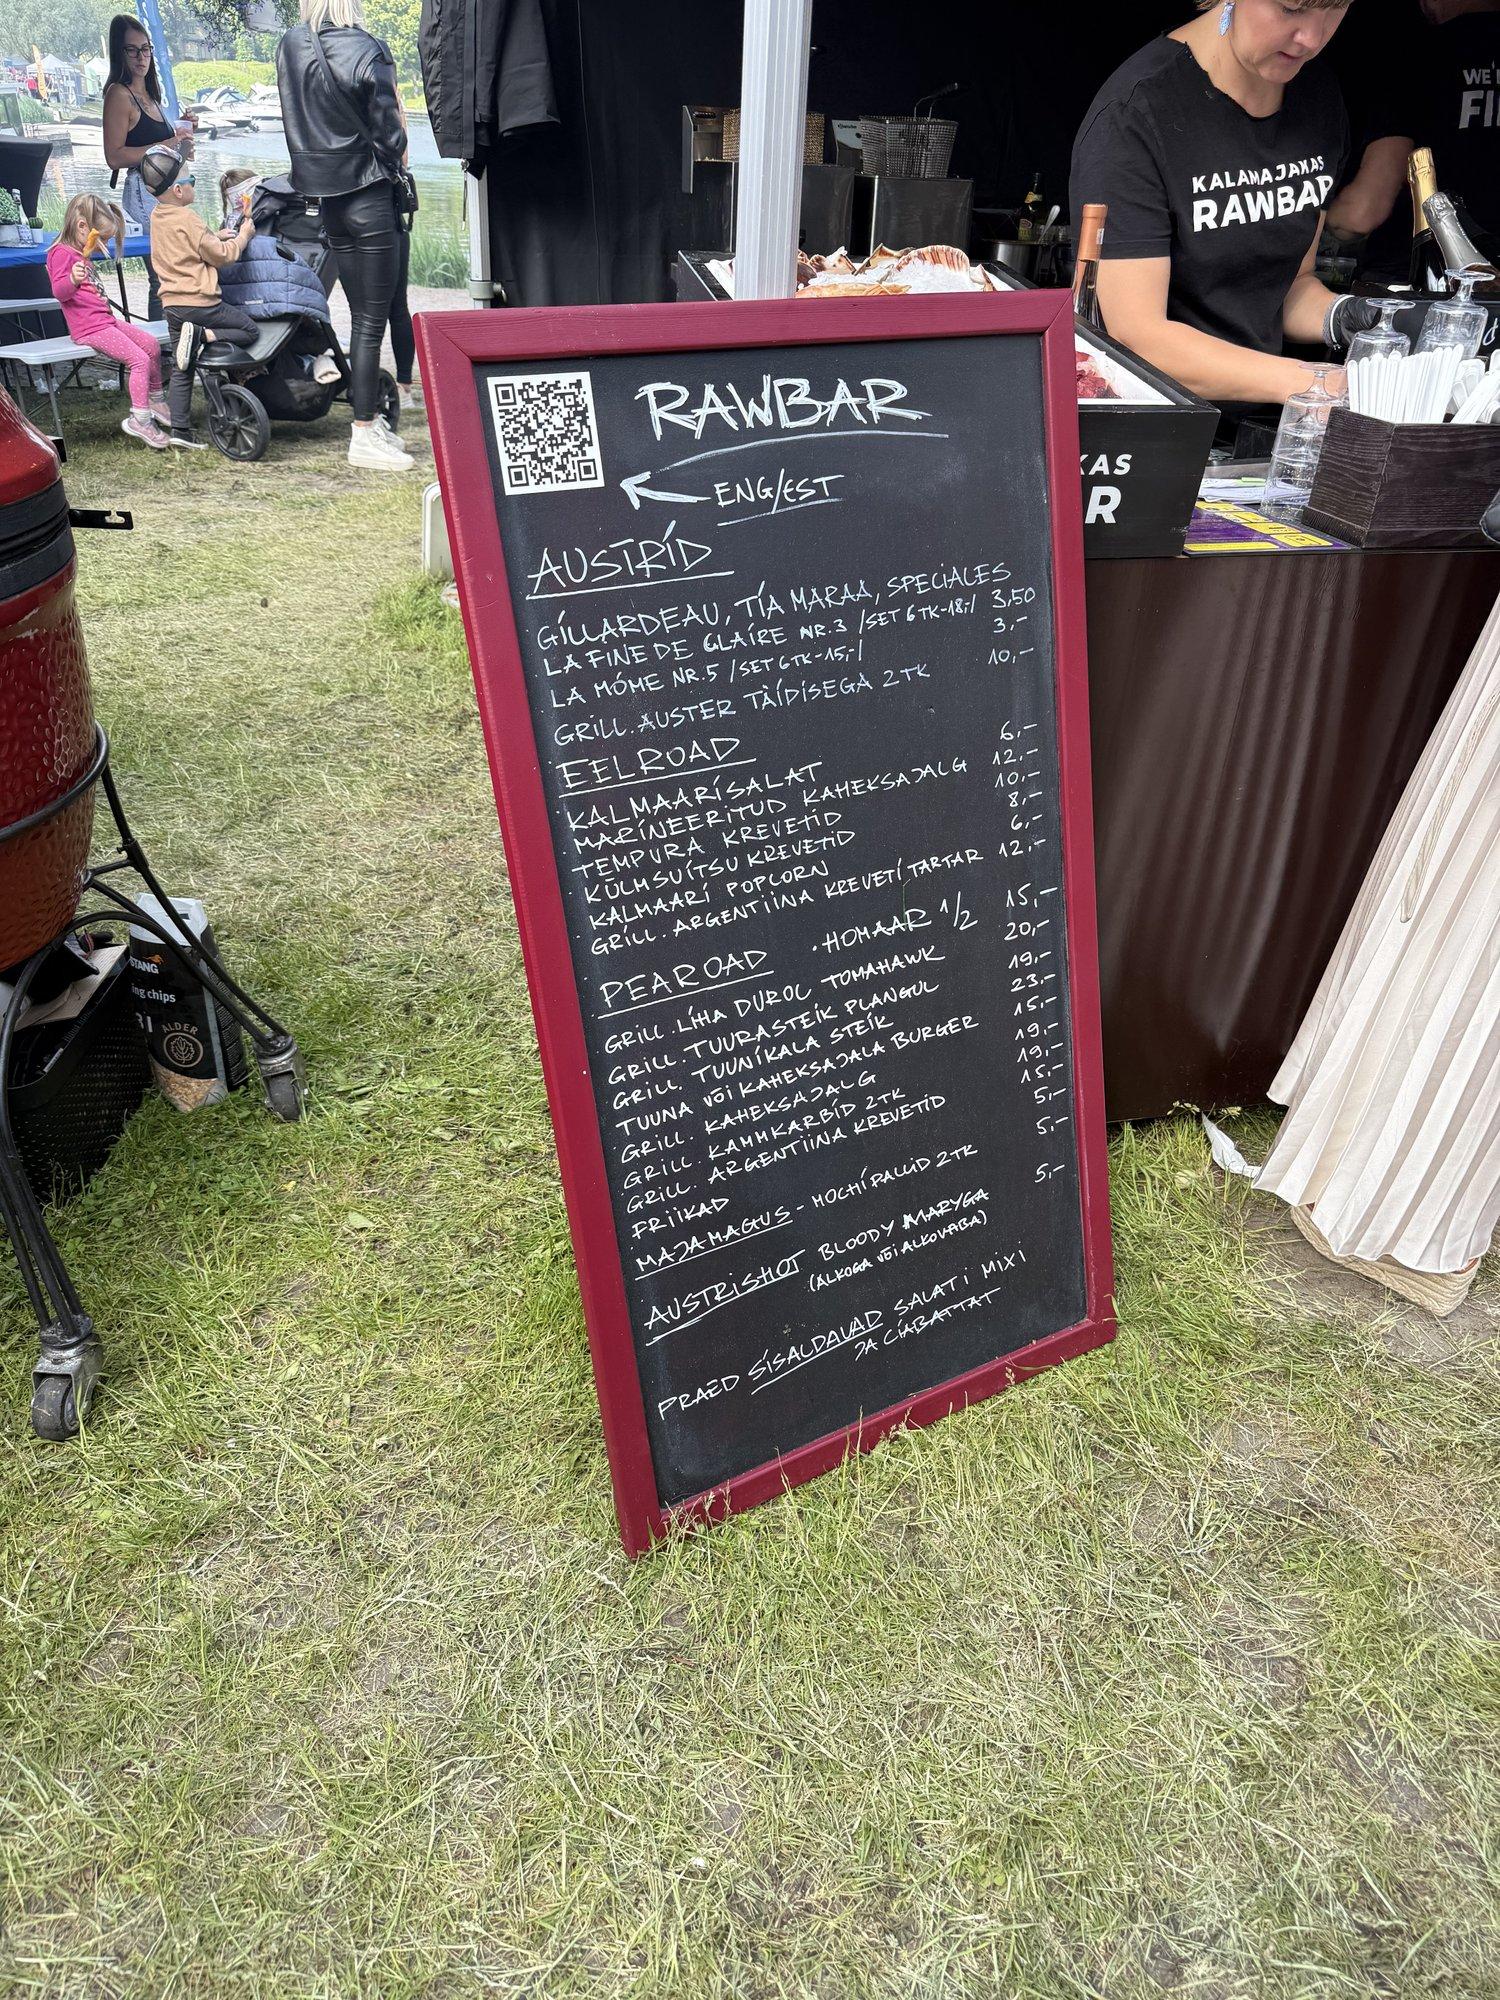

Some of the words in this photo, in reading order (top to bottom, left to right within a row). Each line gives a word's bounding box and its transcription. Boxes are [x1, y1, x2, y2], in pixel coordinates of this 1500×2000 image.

[1192, 155, 1324, 194] KALAMAJAKAS
[634, 373, 932, 440] RAWBAR
[714, 468, 844, 513] ENG/EST
[545, 654, 582, 675] LA
[585, 645, 647, 668] FINE
[653, 640, 693, 660] DE
[992, 587, 1035, 608] 3,50
[551, 687, 586, 708] LA
[638, 699, 736, 732] AUSTER
[556, 738, 740, 788] EELROAD
[571, 837, 705, 878] TEMPURA
[726, 860, 828, 897] POPCORN
[907, 849, 983, 877] TARTAR
[600, 950, 767, 1008] PEAROAD
[821, 945, 945, 989] TOMAHAWK
[147, 989, 176, 1004] chips
[162, 1022, 198, 1035] ALDER
[616, 1102, 693, 1136] TUUNA
[891, 1015, 979, 1050] BURGER
[635, 1206, 791, 1271] MAJAMAGUS
[817, 1219, 894, 1261] BLOODY
[902, 1188, 989, 1230] MARYGA
[855, 1341, 878, 1361] JA
[657, 1374, 739, 1420] PRAED
